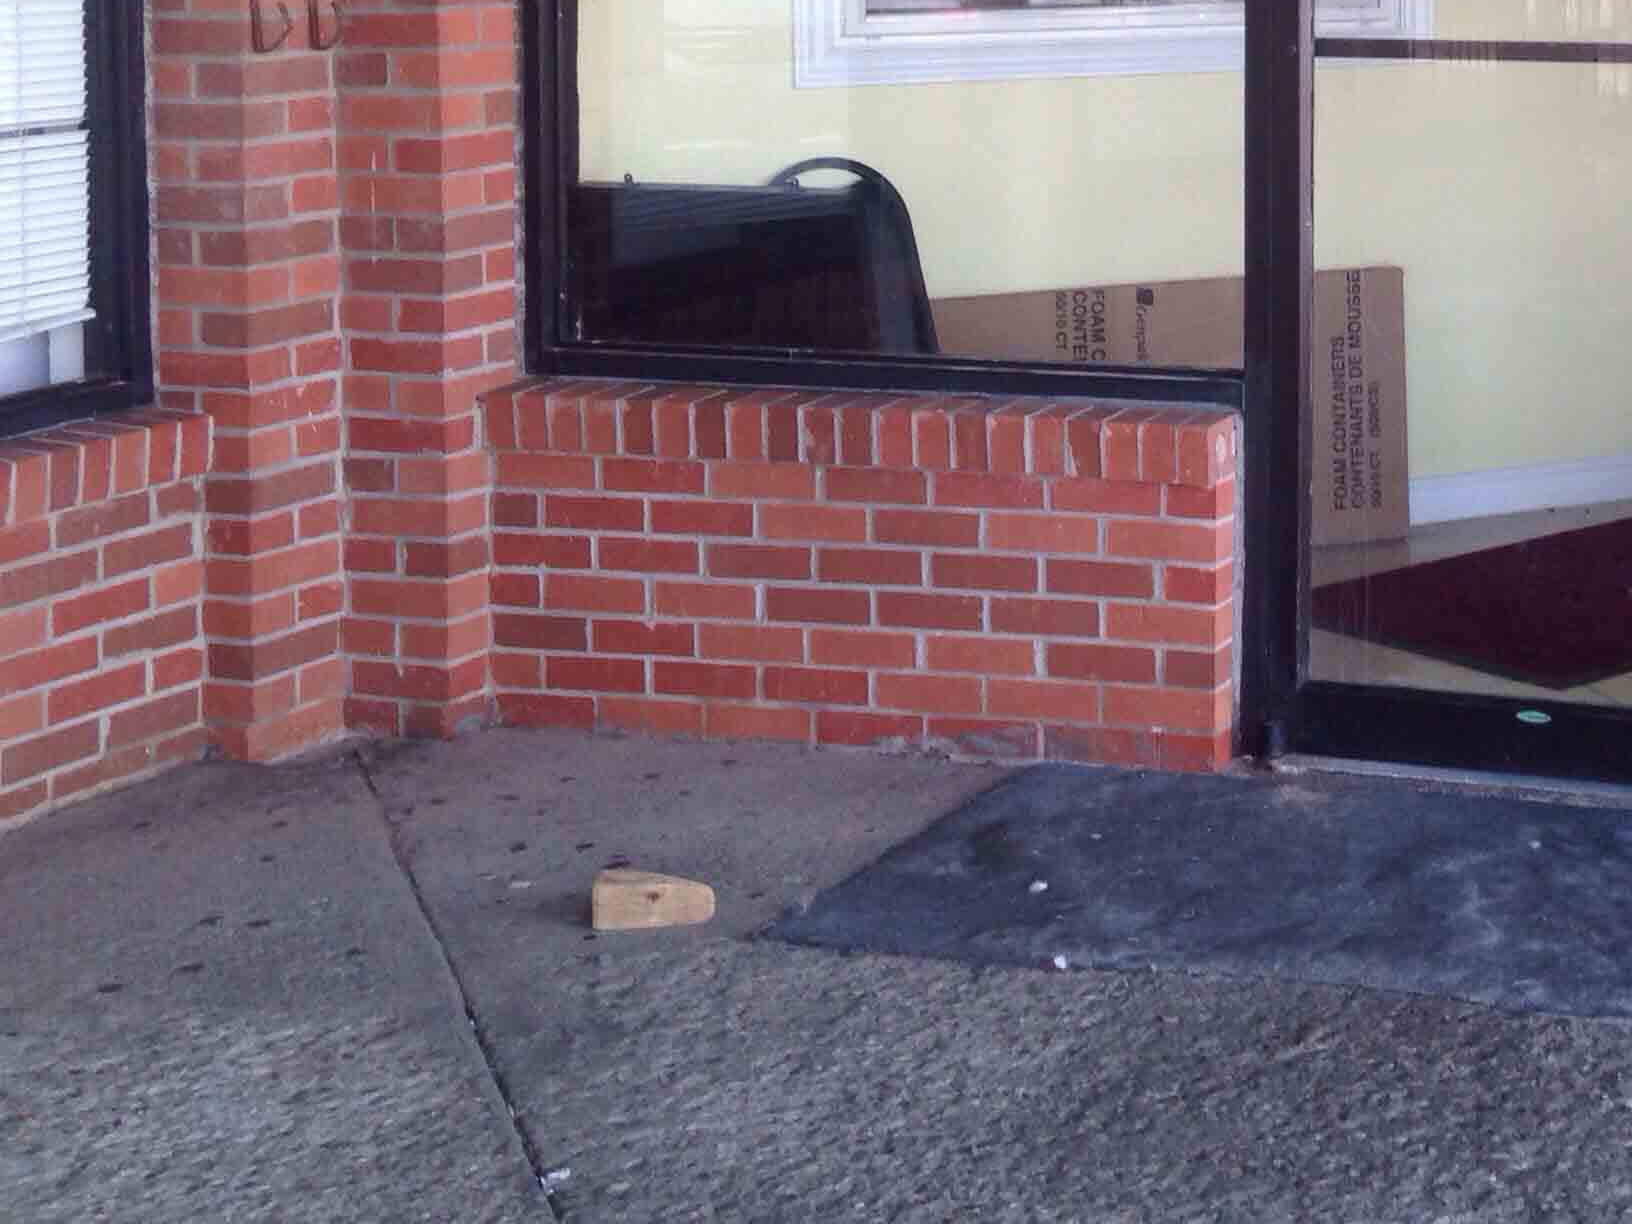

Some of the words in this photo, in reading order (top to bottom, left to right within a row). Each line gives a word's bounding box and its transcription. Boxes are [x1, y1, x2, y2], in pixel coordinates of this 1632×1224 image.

[1089, 288, 1105, 344] FOAM
[1346, 270, 1361, 349] MOUSSE
[1330, 336, 1346, 454] CONTAINERS
[1348, 352, 1362, 380] DE
[1348, 385, 1366, 509] CONTENANTS
[1332, 458, 1349, 511] FOAM
